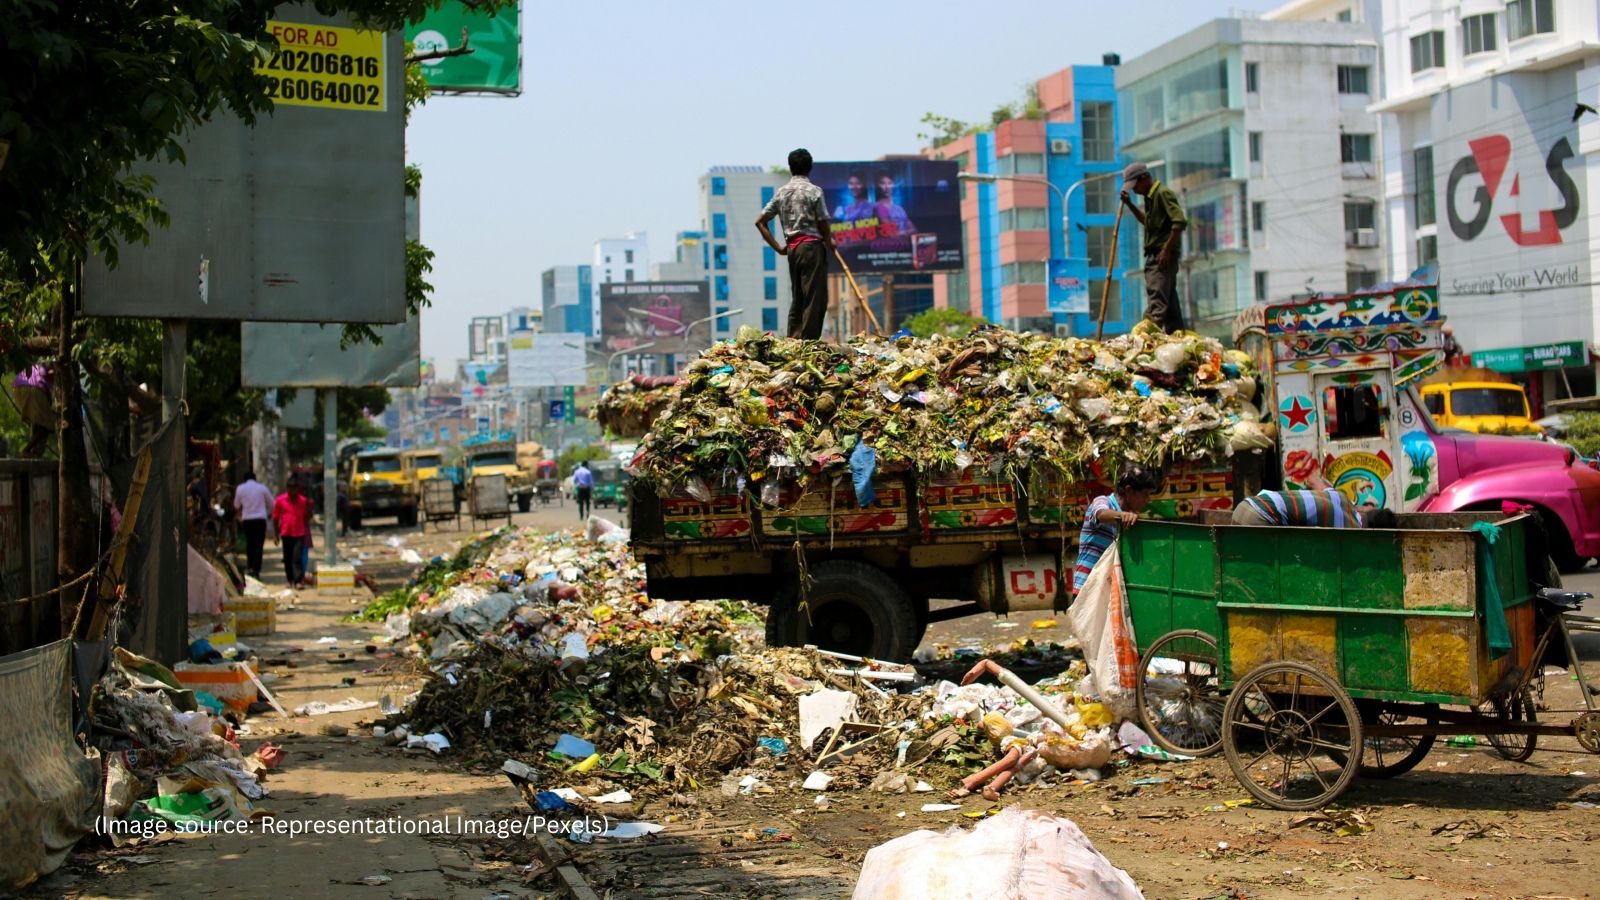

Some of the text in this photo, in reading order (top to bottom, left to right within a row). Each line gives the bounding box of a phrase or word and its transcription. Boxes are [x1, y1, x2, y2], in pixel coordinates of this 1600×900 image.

[272, 26, 338, 47] FOR AD
[251, 48, 379, 78] 20206816
[1446, 134, 1580, 247] G4S
[1496, 271, 1526, 290] Your
[1533, 264, 1578, 286] World
